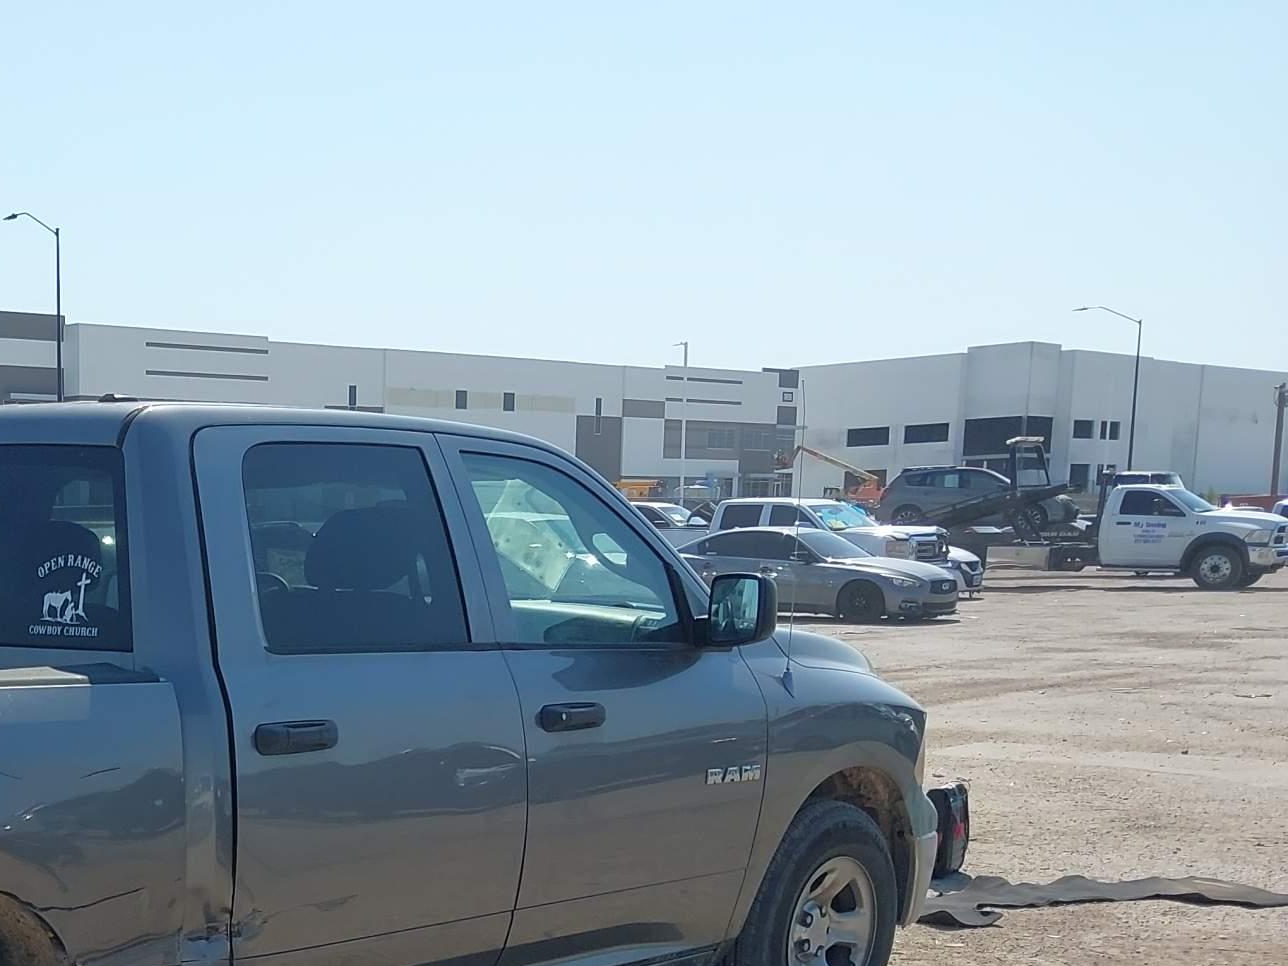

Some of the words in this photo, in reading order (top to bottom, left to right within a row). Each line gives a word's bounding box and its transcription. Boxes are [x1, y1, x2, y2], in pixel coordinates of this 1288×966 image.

[37, 555, 65, 578] OPEN
[67, 554, 103, 578] RANGE
[29, 624, 62, 636] COWBOY
[63, 626, 98, 637] CHURCH
[705, 764, 761, 785] RAM
